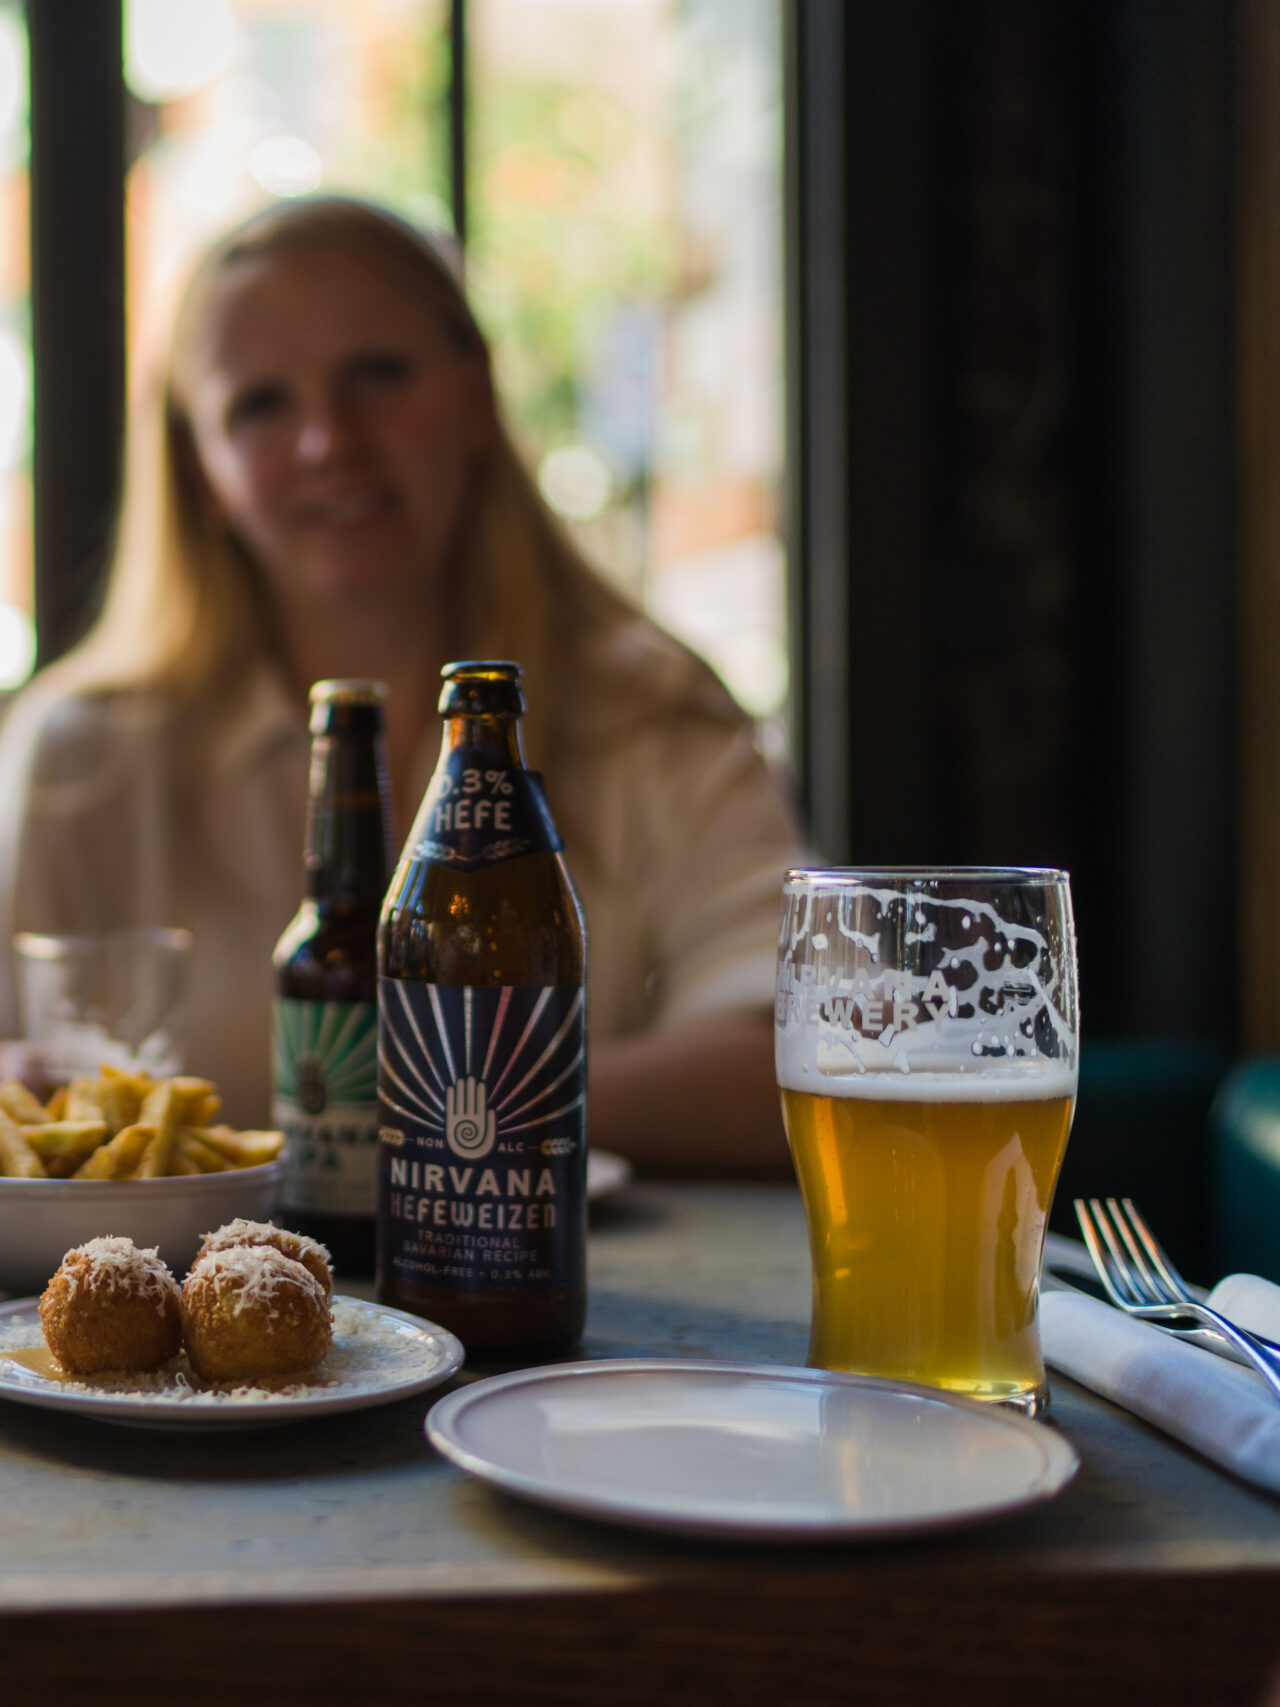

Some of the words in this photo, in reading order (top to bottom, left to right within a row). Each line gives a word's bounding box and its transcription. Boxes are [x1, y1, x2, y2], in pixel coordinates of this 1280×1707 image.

[435, 798, 511, 832] HEFE
[417, 1136, 444, 1149] NON
[497, 1142, 525, 1153] ALC
[390, 1157, 556, 1197] NIRVANA
[390, 1191, 557, 1230] HEFEWEIZEN
[403, 1239, 475, 1261] BAVARIAN
[482, 1250, 538, 1262] RECIPE
[417, 1229, 520, 1249] TRADITIONAL
